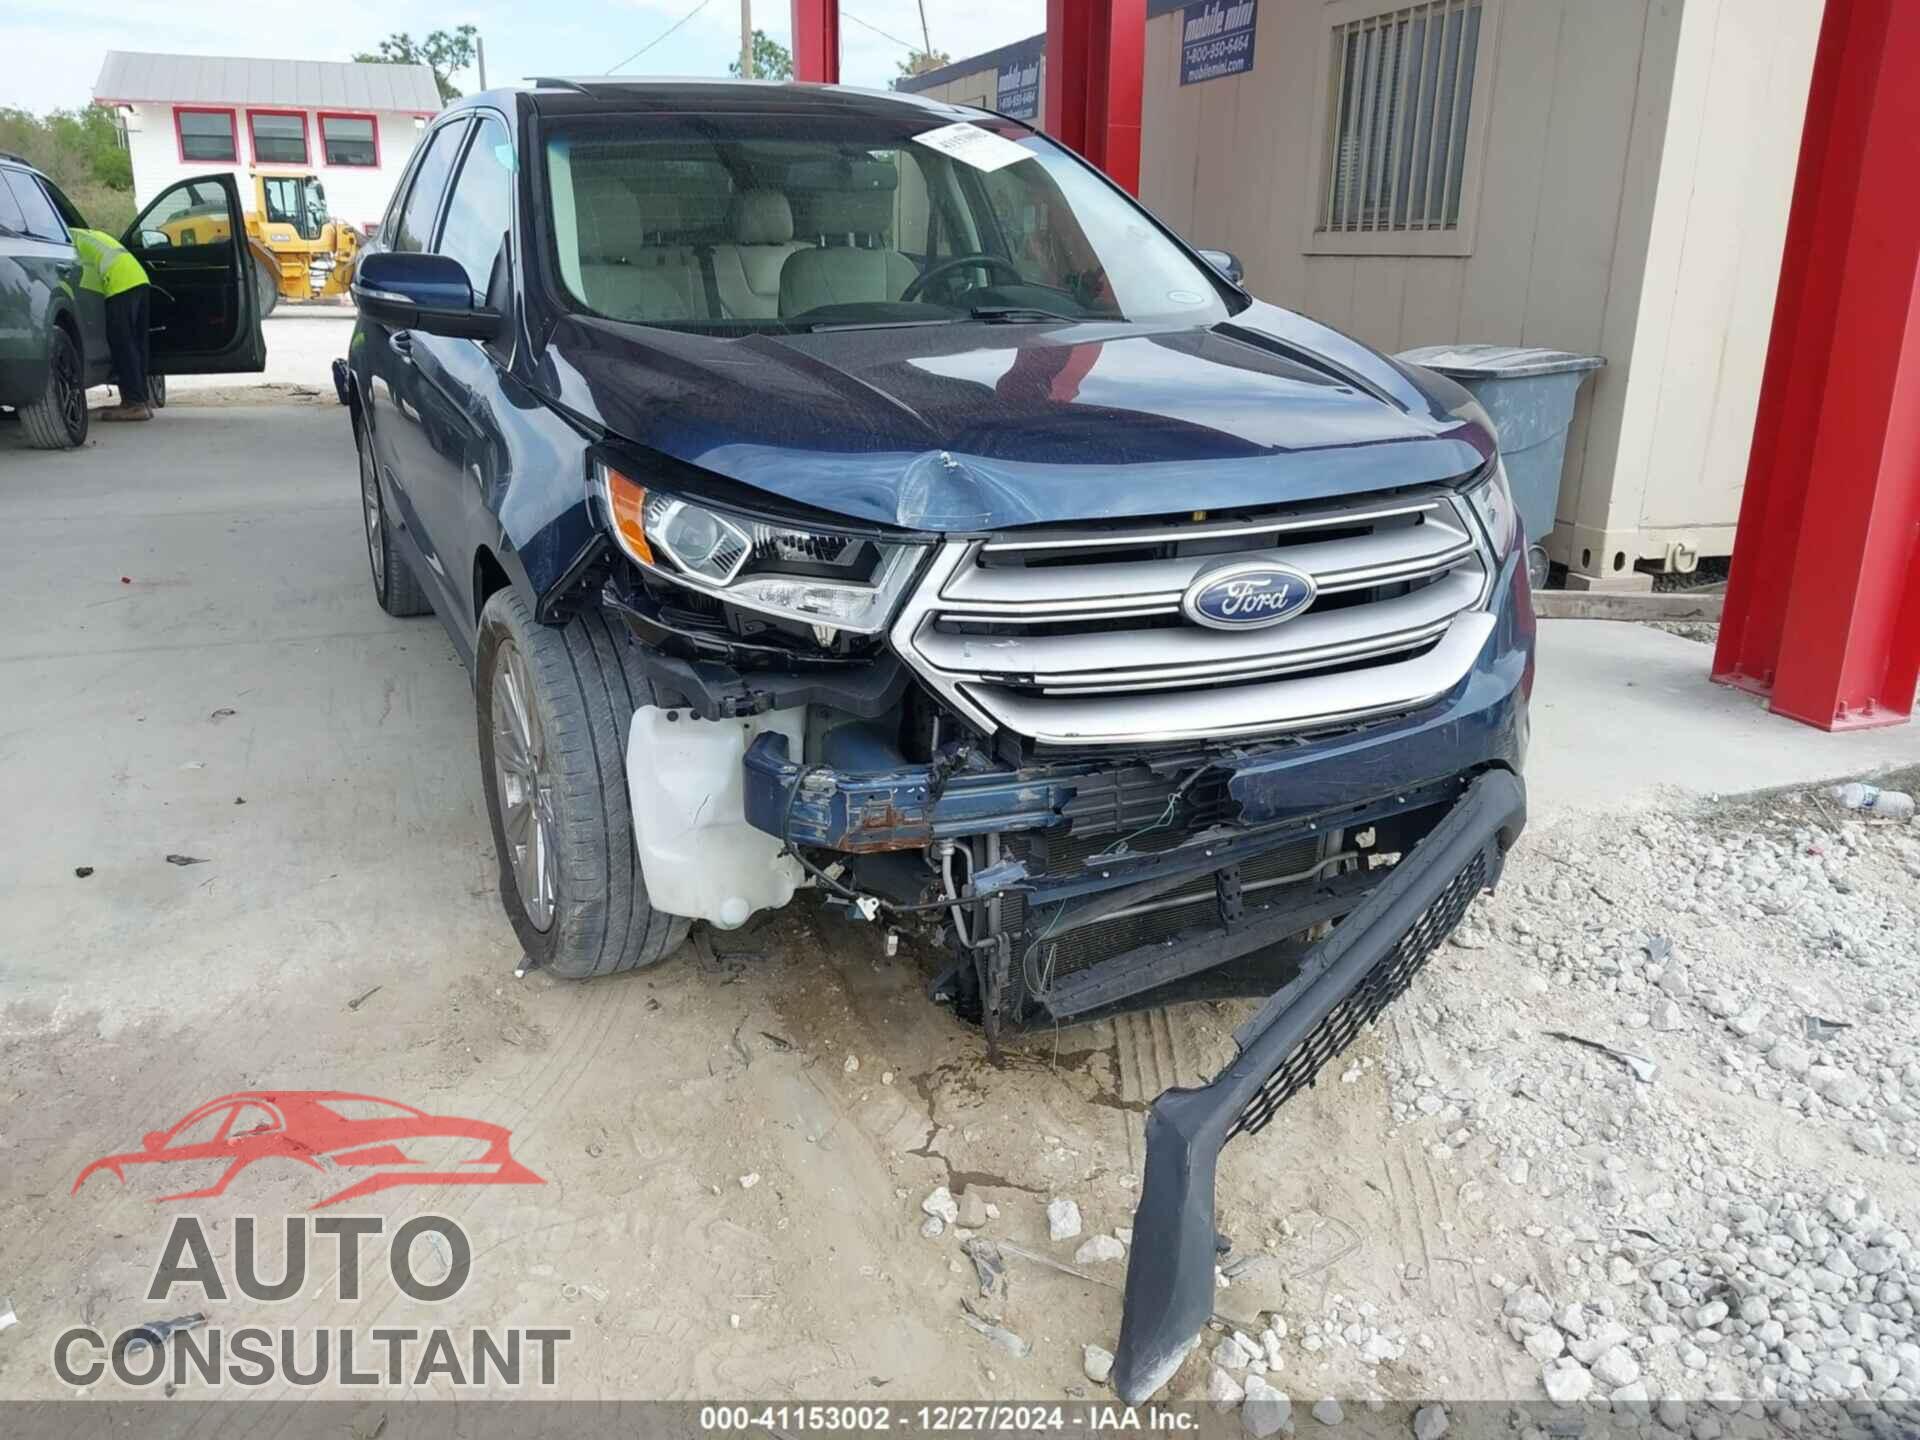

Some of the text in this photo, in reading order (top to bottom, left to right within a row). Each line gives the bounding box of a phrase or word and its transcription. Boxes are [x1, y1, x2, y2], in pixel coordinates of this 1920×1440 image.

[1184, 0, 1255, 42] mobile mini
[1187, 58, 1245, 83] mobilemini.com
[1215, 578, 1289, 615] Ford
